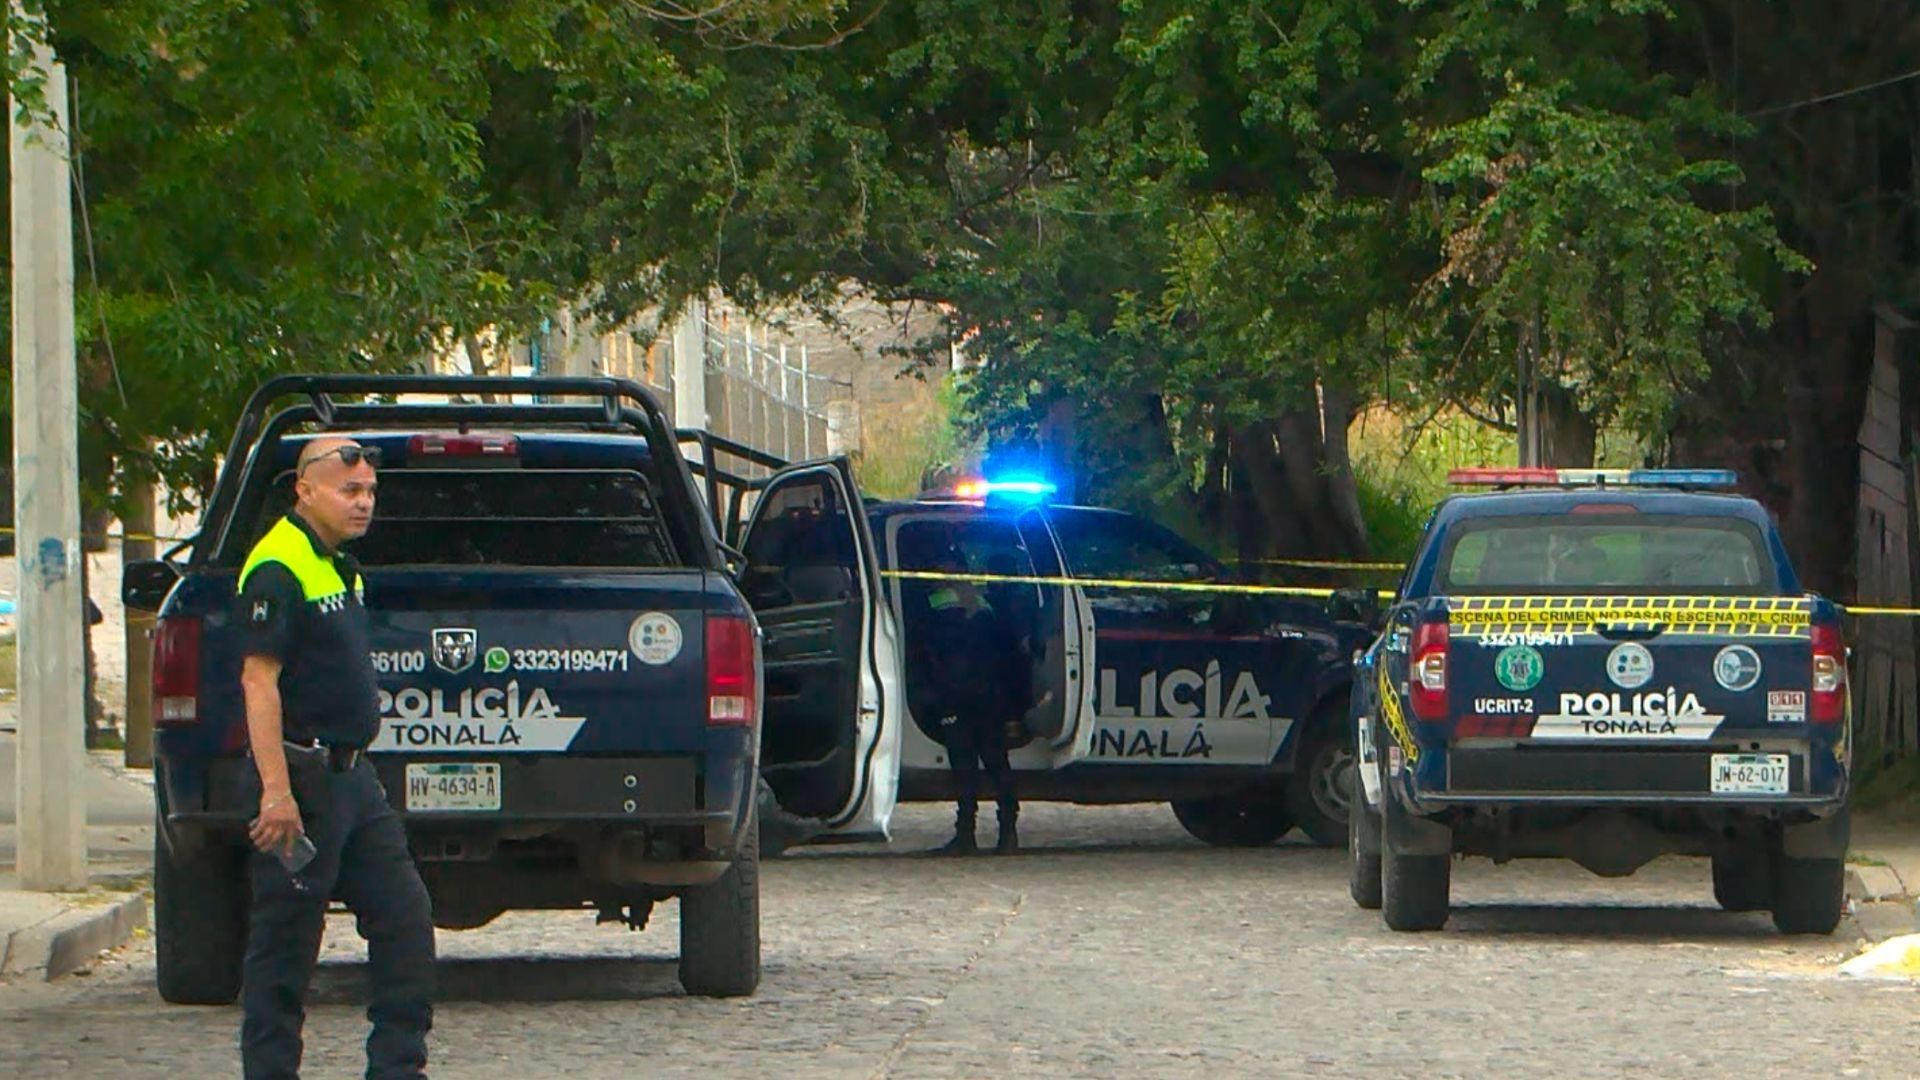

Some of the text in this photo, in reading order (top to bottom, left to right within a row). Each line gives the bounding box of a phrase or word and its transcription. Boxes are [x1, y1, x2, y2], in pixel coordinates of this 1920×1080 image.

[1507, 610, 1536, 623] DEL
[1539, 610, 1595, 622] CRIMEN
[1599, 610, 1620, 621] NO
[1624, 610, 1673, 622] PASAR
[1676, 610, 1735, 623] ESCENA
[1738, 611, 1767, 623] DEL
[1477, 632, 1574, 646] 3323199471
[513, 649, 628, 671] 3323199471
[1474, 698, 1534, 713] UCRIT-2
[1560, 685, 1706, 717] POLICÍA
[390, 719, 521, 745] TONALÁ
[1581, 716, 1676, 735] TONALÁ
[411, 776, 496, 797] HV-4634-A
